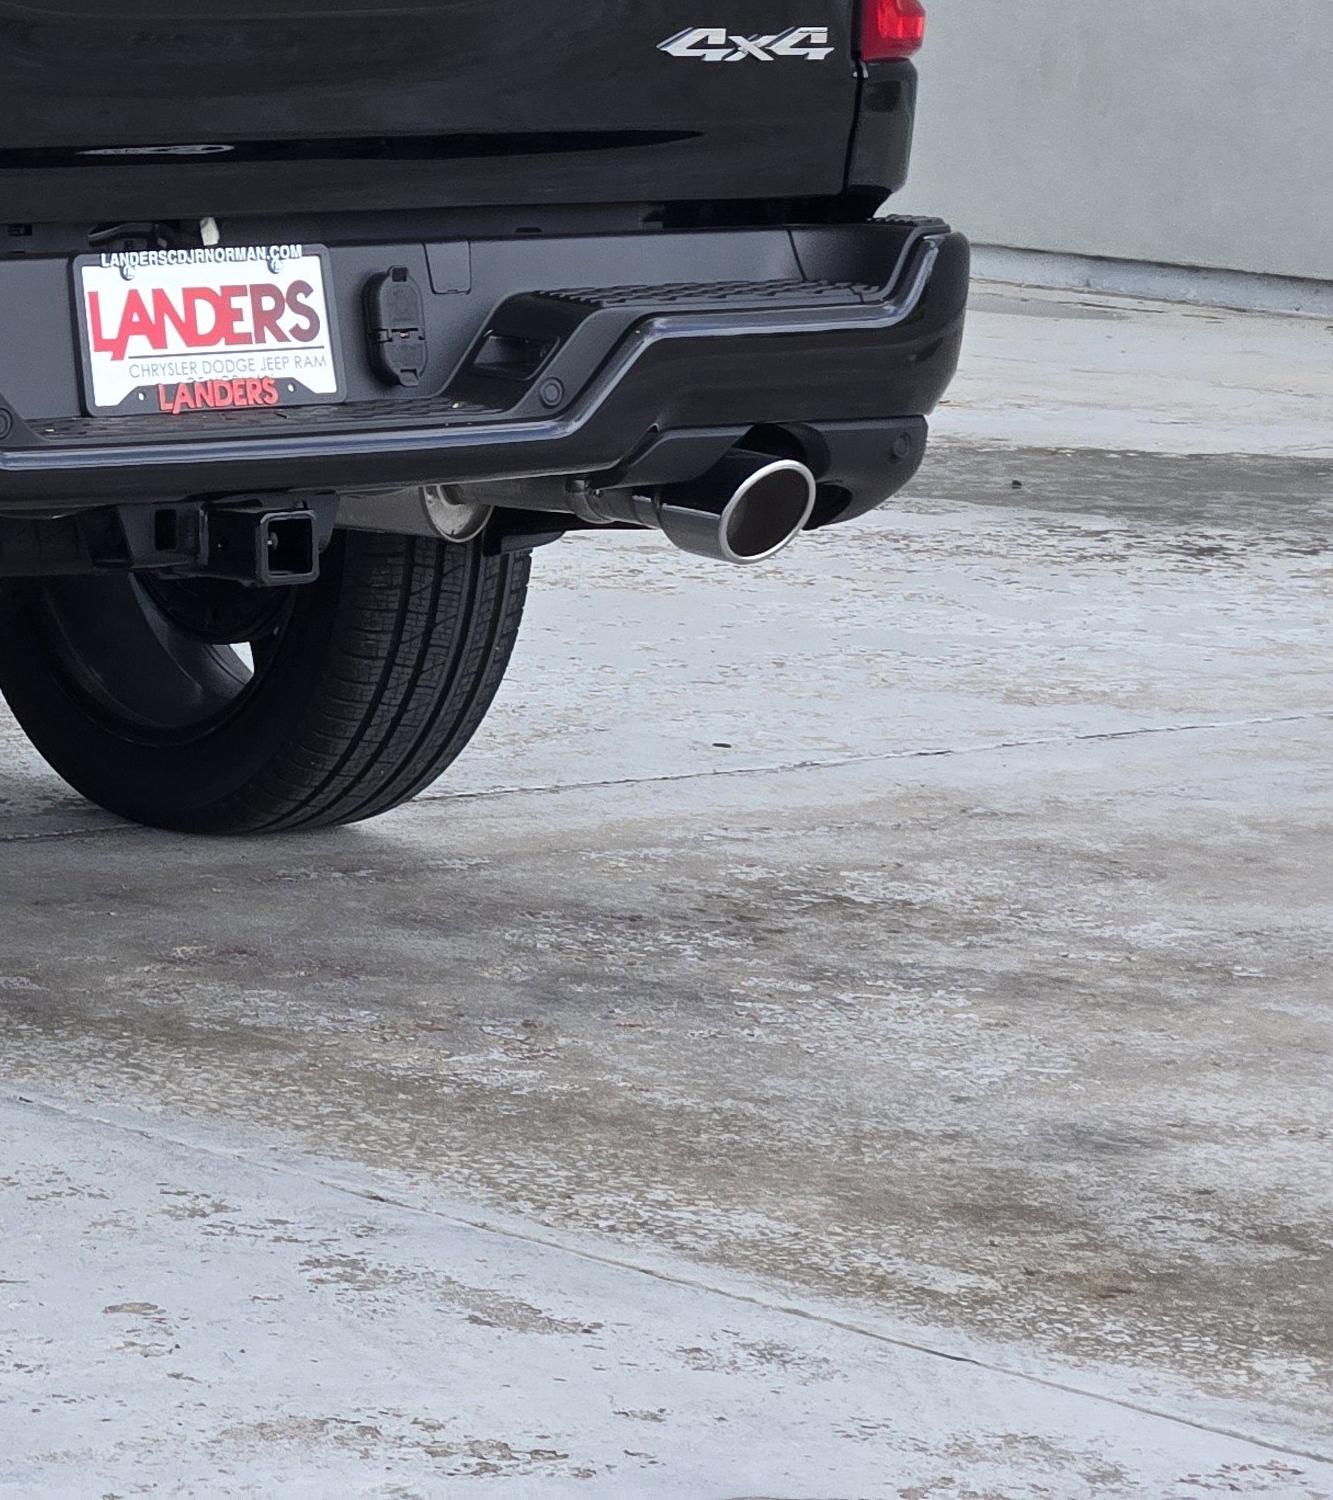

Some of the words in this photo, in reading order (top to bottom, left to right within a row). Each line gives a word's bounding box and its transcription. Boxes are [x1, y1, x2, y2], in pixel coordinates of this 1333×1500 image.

[100, 244, 302, 268] LANDERSCDJRNORMAN.COM
[88, 280, 321, 361] LANDERS
[129, 360, 197, 378] CHRYSLER
[203, 358, 255, 375] DODGE
[261, 357, 289, 372] JEEP
[295, 355, 327, 369] RAM
[157, 377, 279, 414] LANDERS
